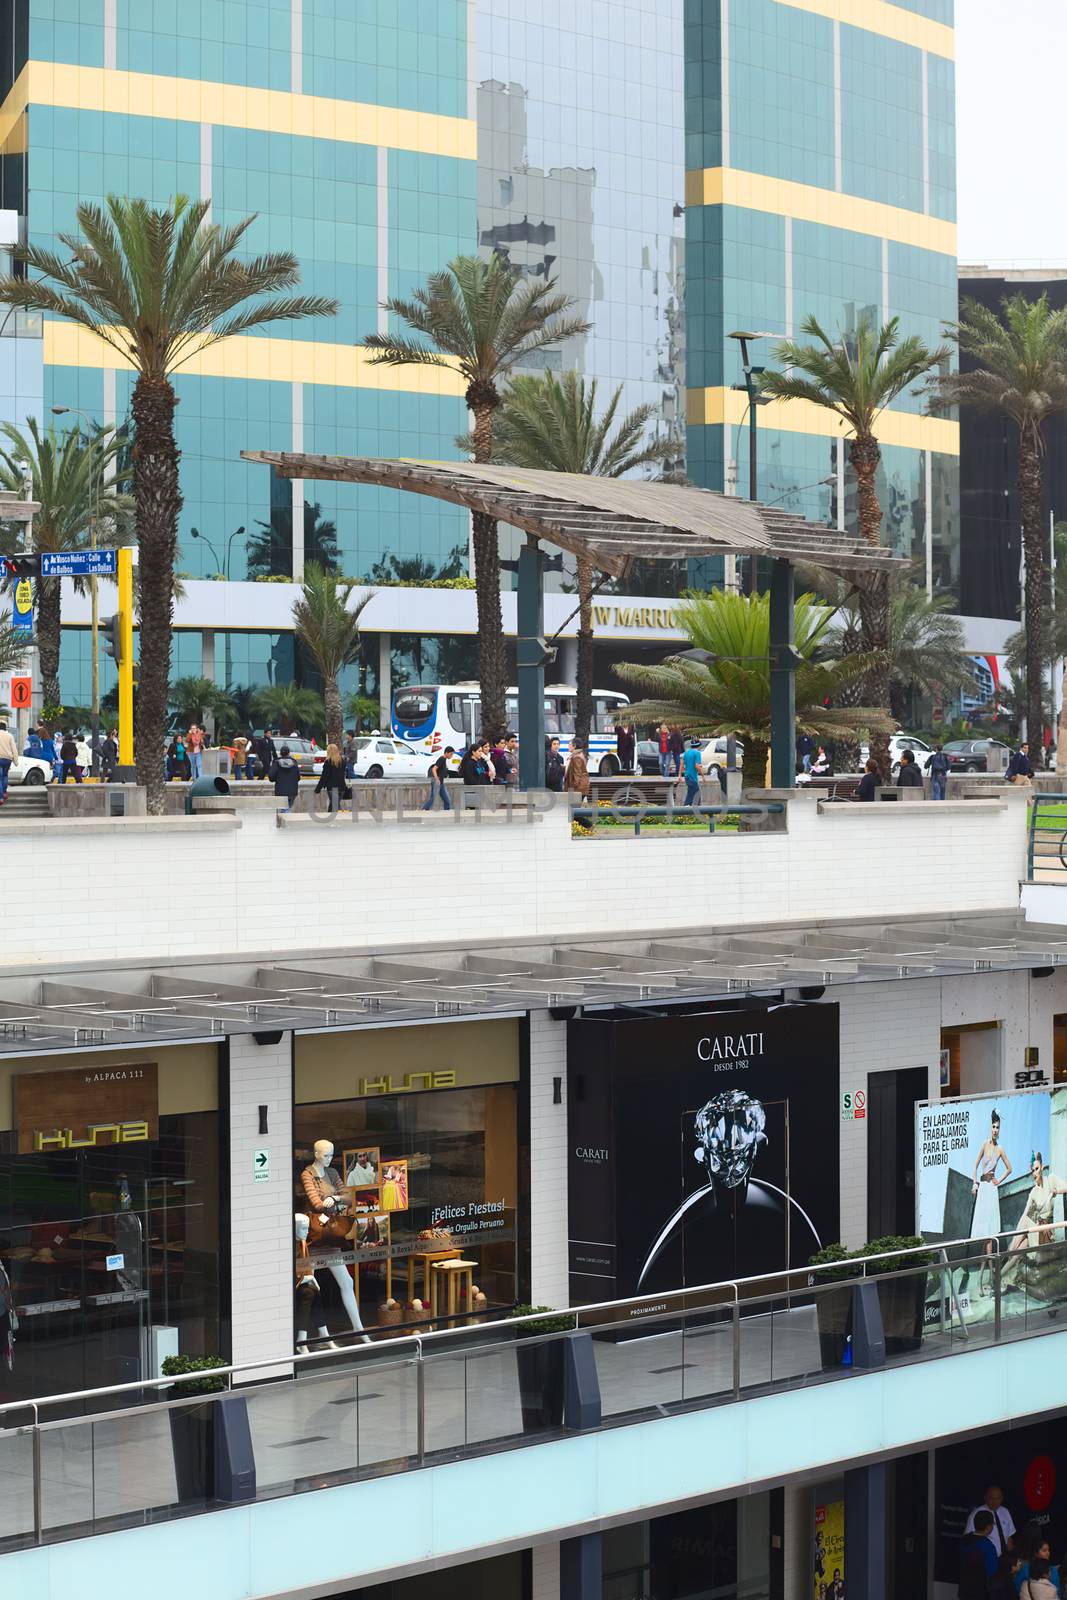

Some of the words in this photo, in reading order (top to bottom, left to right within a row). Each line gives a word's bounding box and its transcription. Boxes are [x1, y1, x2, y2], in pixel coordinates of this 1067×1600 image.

[88, 553, 101, 562] Calle
[50, 566, 56, 574] de
[56, 565, 73, 574] Balboa
[88, 563, 97, 573] Las
[697, 1032, 764, 1061] CARATI
[714, 1062, 733, 1072] DESDE
[735, 1060, 749, 1070] 1982
[94, 1072, 127, 1081] ALPACA
[844, 1094, 851, 1108] S
[923, 1116, 932, 1128] EN
[933, 1111, 970, 1126] LARCOMAR
[923, 1124, 968, 1141] TRABAJAMOS
[923, 1141, 940, 1154] PARA
[941, 1140, 950, 1151] EL
[950, 1137, 969, 1150] GRAN
[575, 1147, 609, 1160] CARATI
[923, 1152, 949, 1167] CAMBIO
[431, 1205, 466, 1225] ¡Felices
[468, 1198, 505, 1216] Fiestas!
[455, 1222, 479, 1234] Orgullo
[480, 1219, 504, 1229] Peruano
